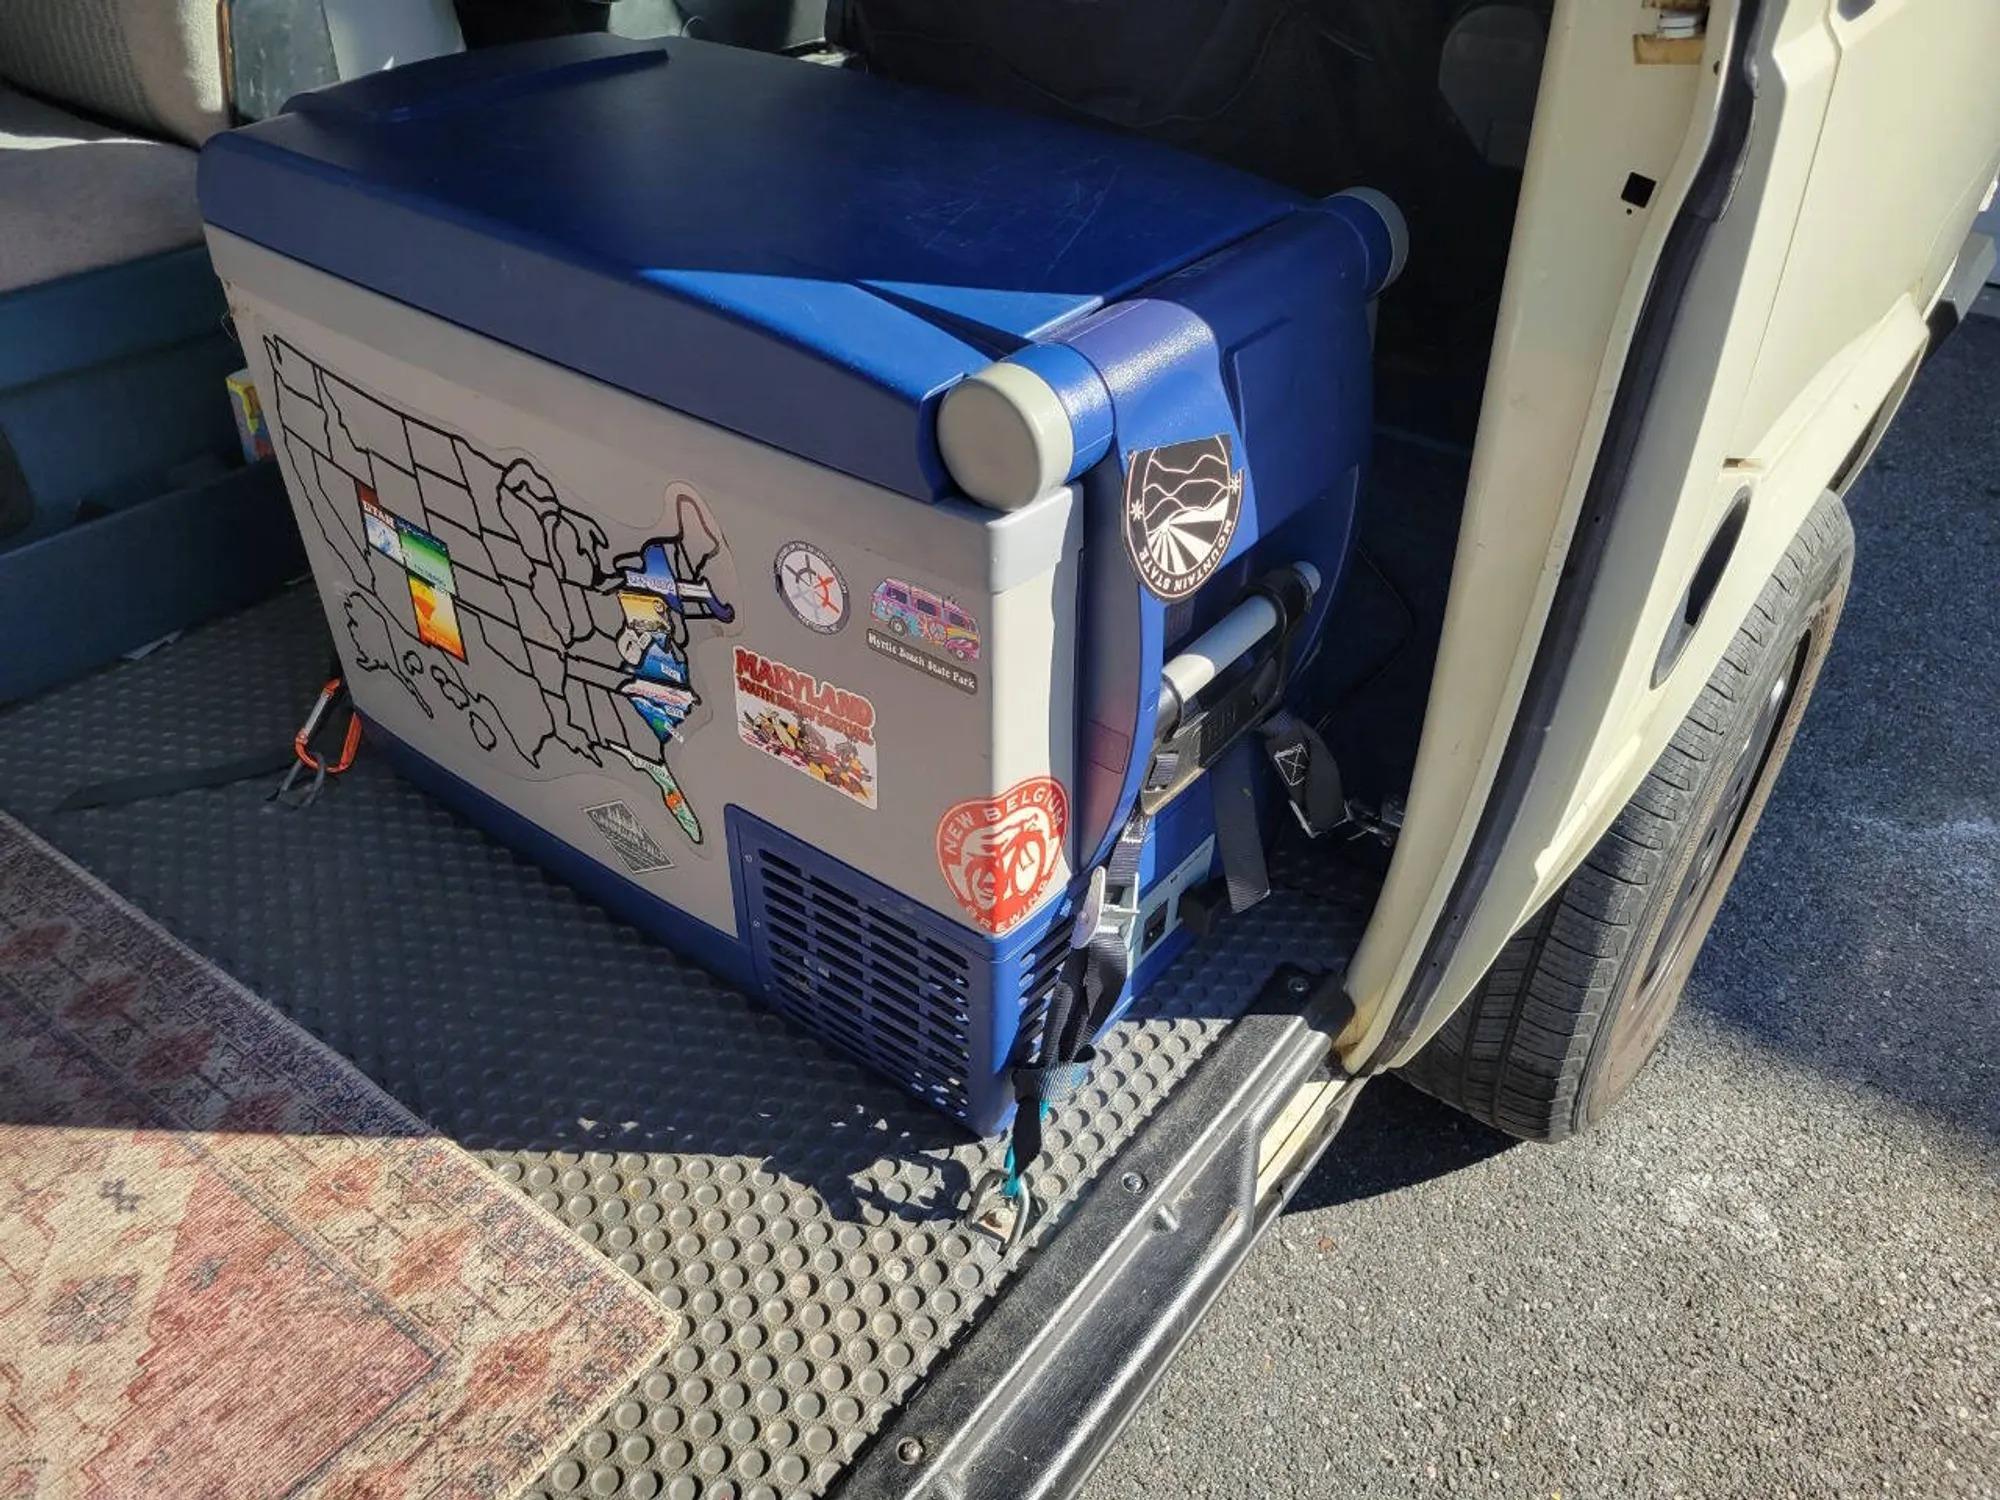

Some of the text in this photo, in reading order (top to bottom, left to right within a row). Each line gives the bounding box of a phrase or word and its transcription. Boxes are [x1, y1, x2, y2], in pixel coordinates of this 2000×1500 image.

[362, 499, 396, 529] UTAH
[1138, 519, 1233, 592] MOUNTAIN STATE
[734, 647, 875, 729] MARYLAND
[898, 647, 925, 667] Beach
[926, 660, 951, 678] State
[952, 671, 975, 689] Park
[943, 787, 1064, 855] NEW BELGIUM
[966, 880, 1050, 933] BREWING
